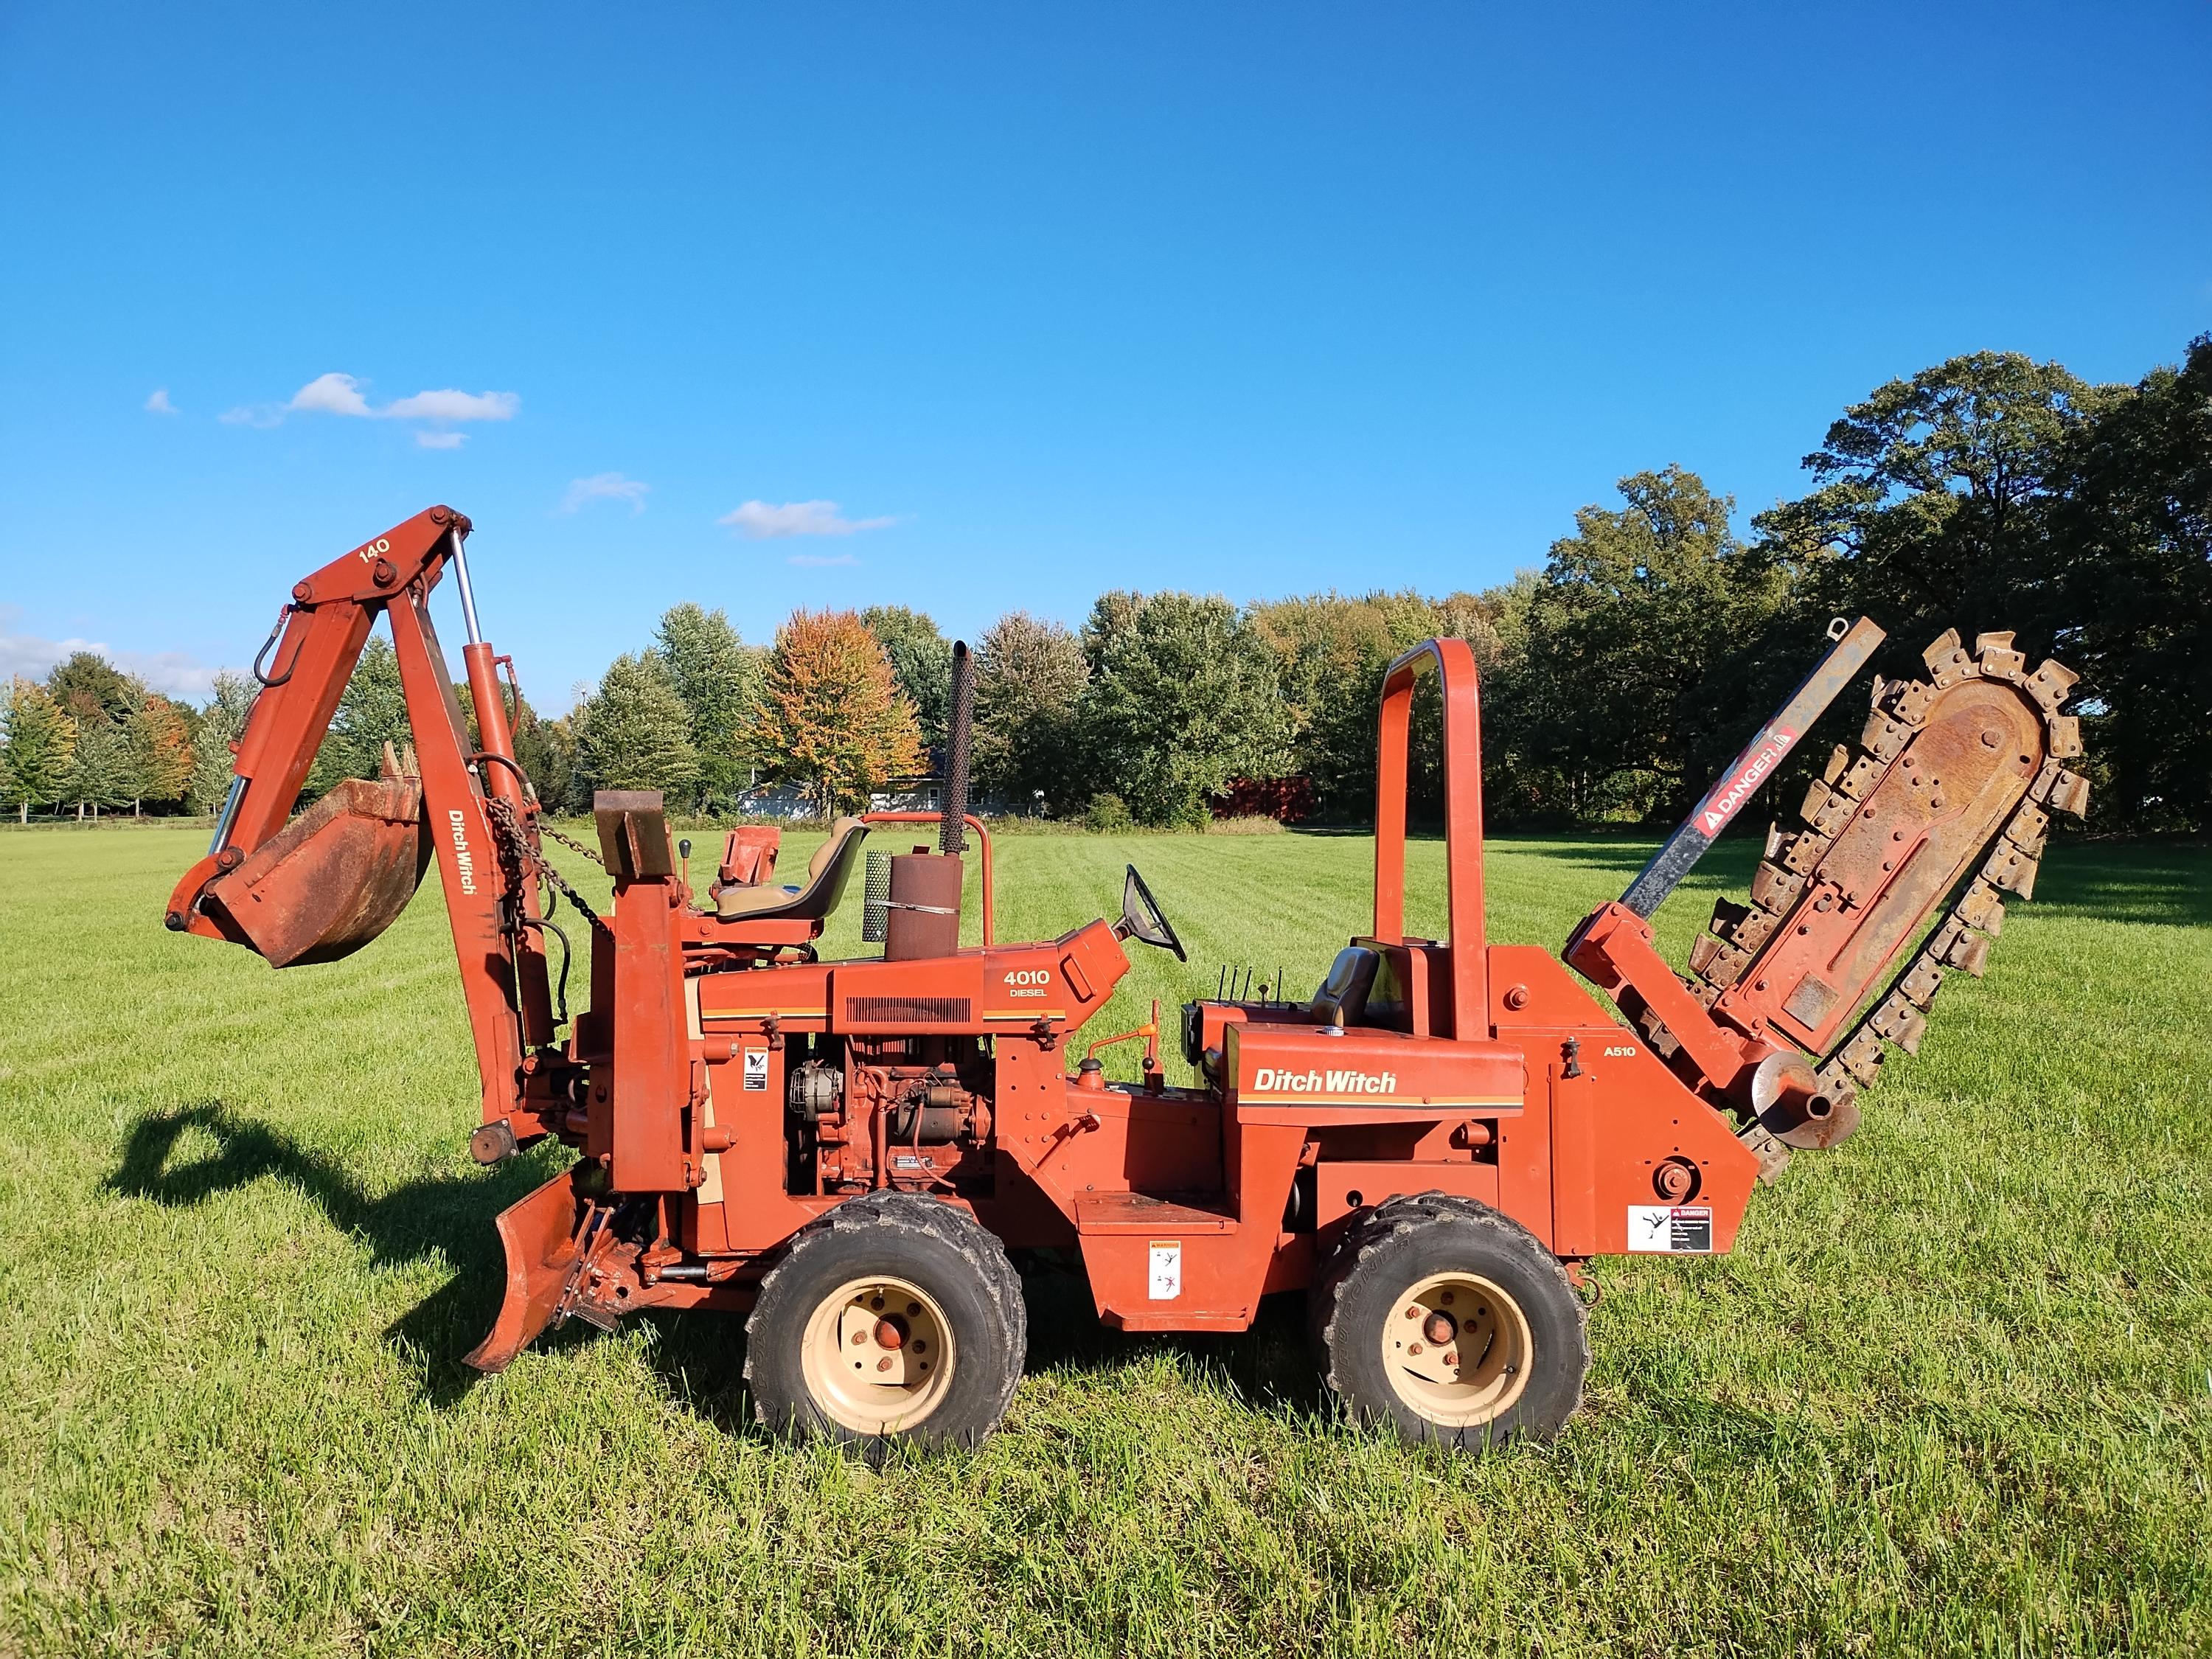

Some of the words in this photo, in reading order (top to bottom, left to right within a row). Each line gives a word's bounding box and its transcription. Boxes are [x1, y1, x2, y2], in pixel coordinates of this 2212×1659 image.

[359, 539, 389, 563] 140
[1718, 748, 1777, 813] DANGER
[448, 810, 468, 851] Ditch
[457, 852, 476, 895] Witch
[1004, 970, 1050, 985] 4010
[1010, 989, 1047, 997] DIESEL
[1604, 1047, 1635, 1056] A510
[1254, 1069, 1323, 1091] Ditch
[1326, 1071, 1397, 1093] Witch
